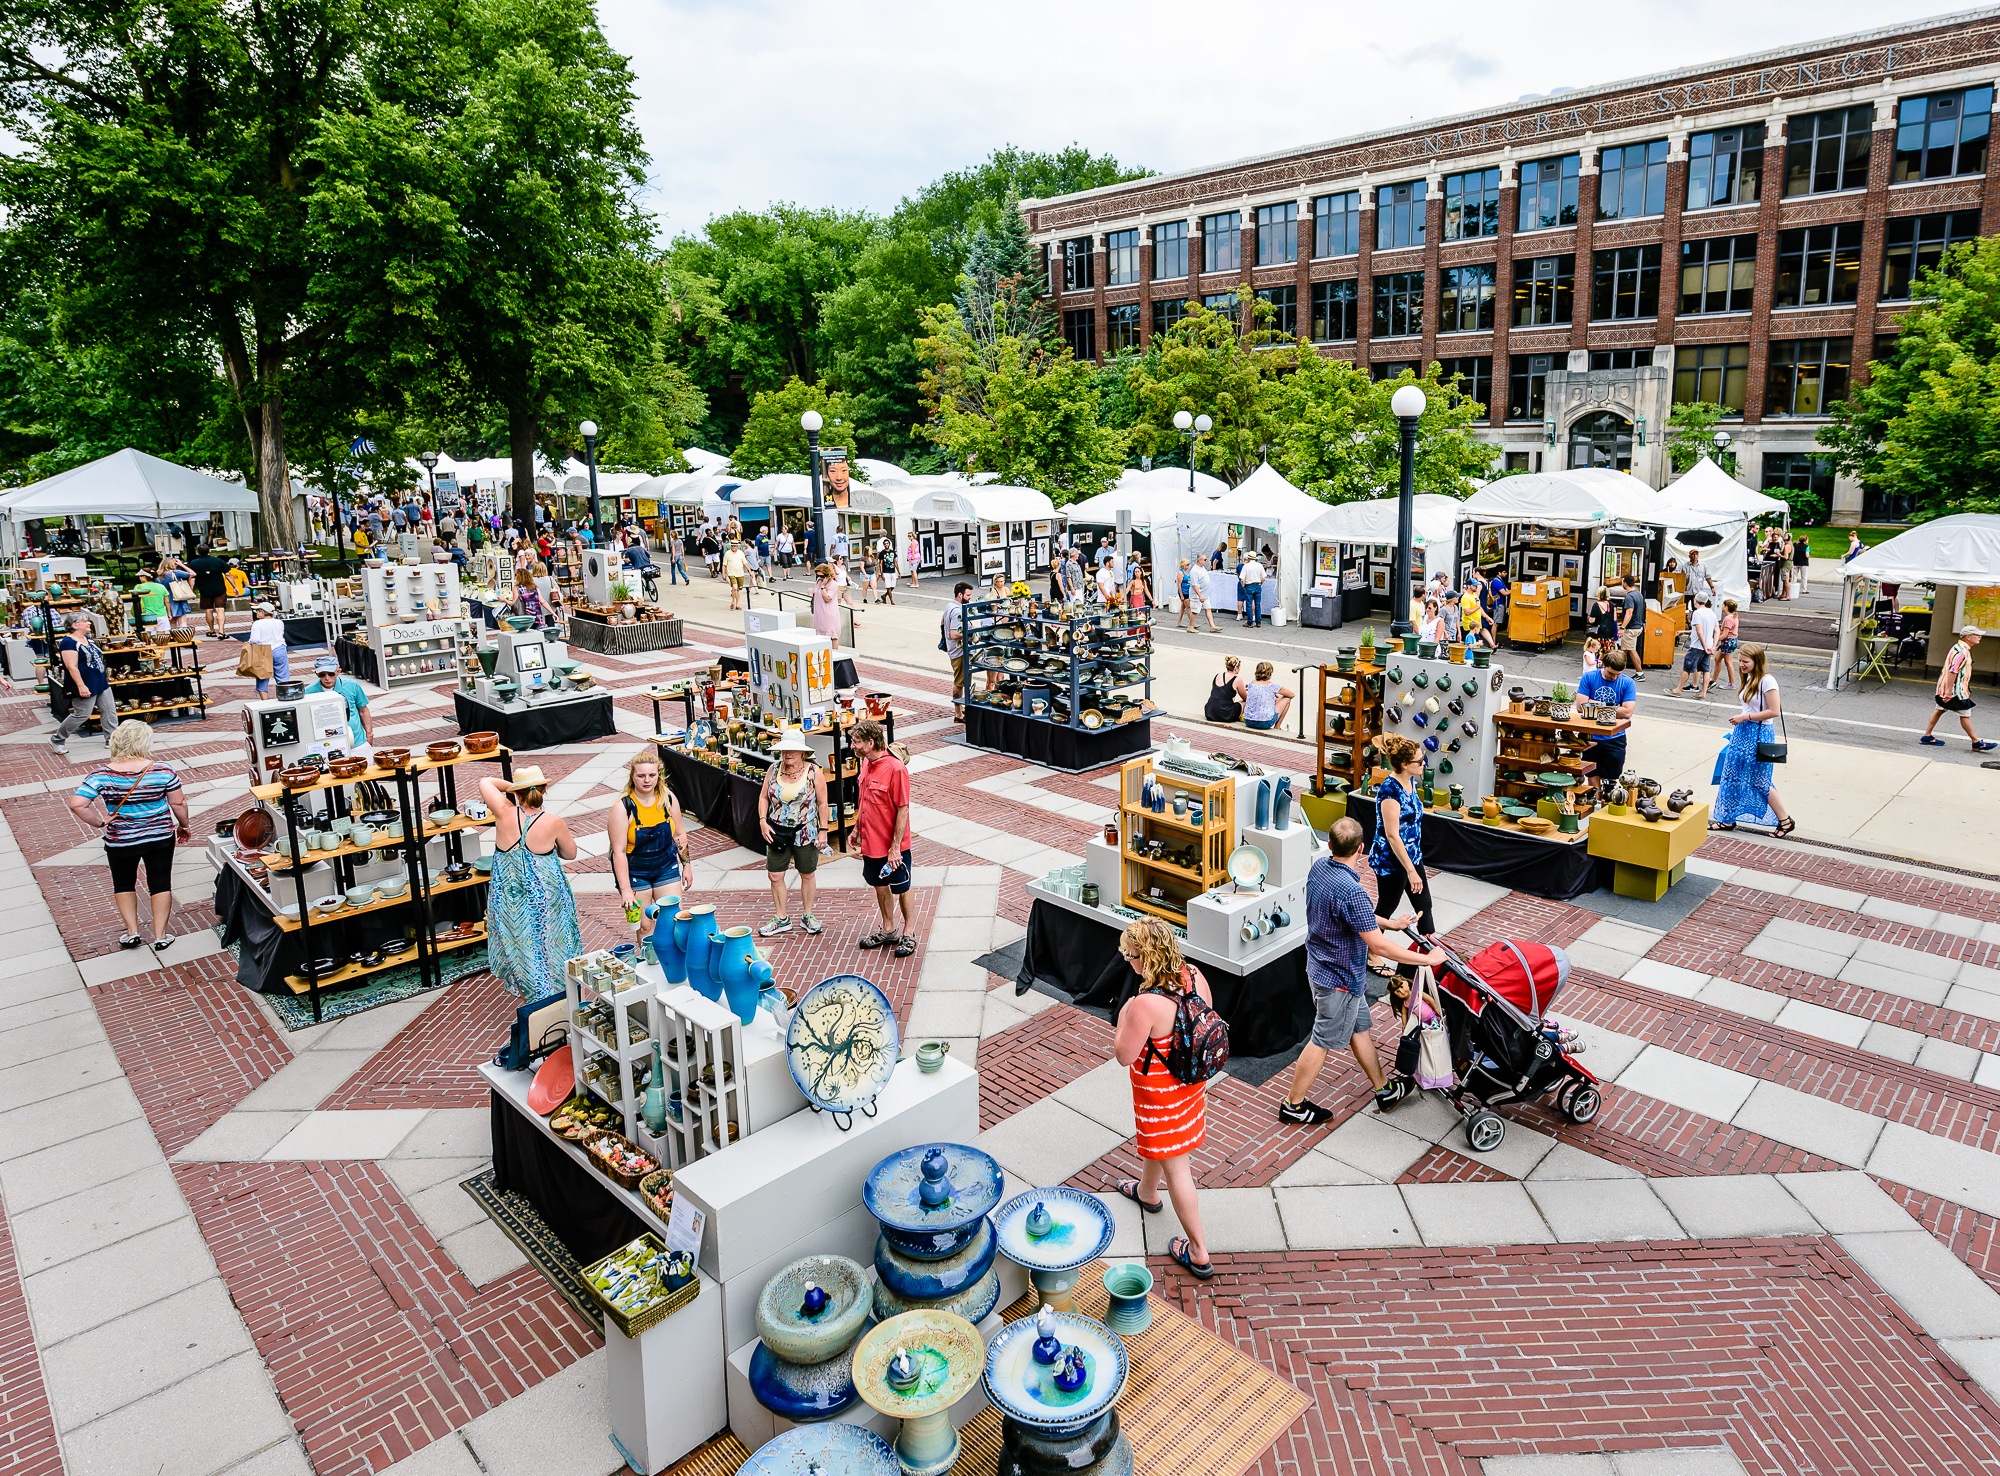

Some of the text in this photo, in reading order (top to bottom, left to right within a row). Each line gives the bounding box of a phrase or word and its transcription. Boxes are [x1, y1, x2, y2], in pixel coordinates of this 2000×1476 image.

[1424, 45, 1904, 155] NATURAL SCIENCE
[837, 535, 847, 543] M
